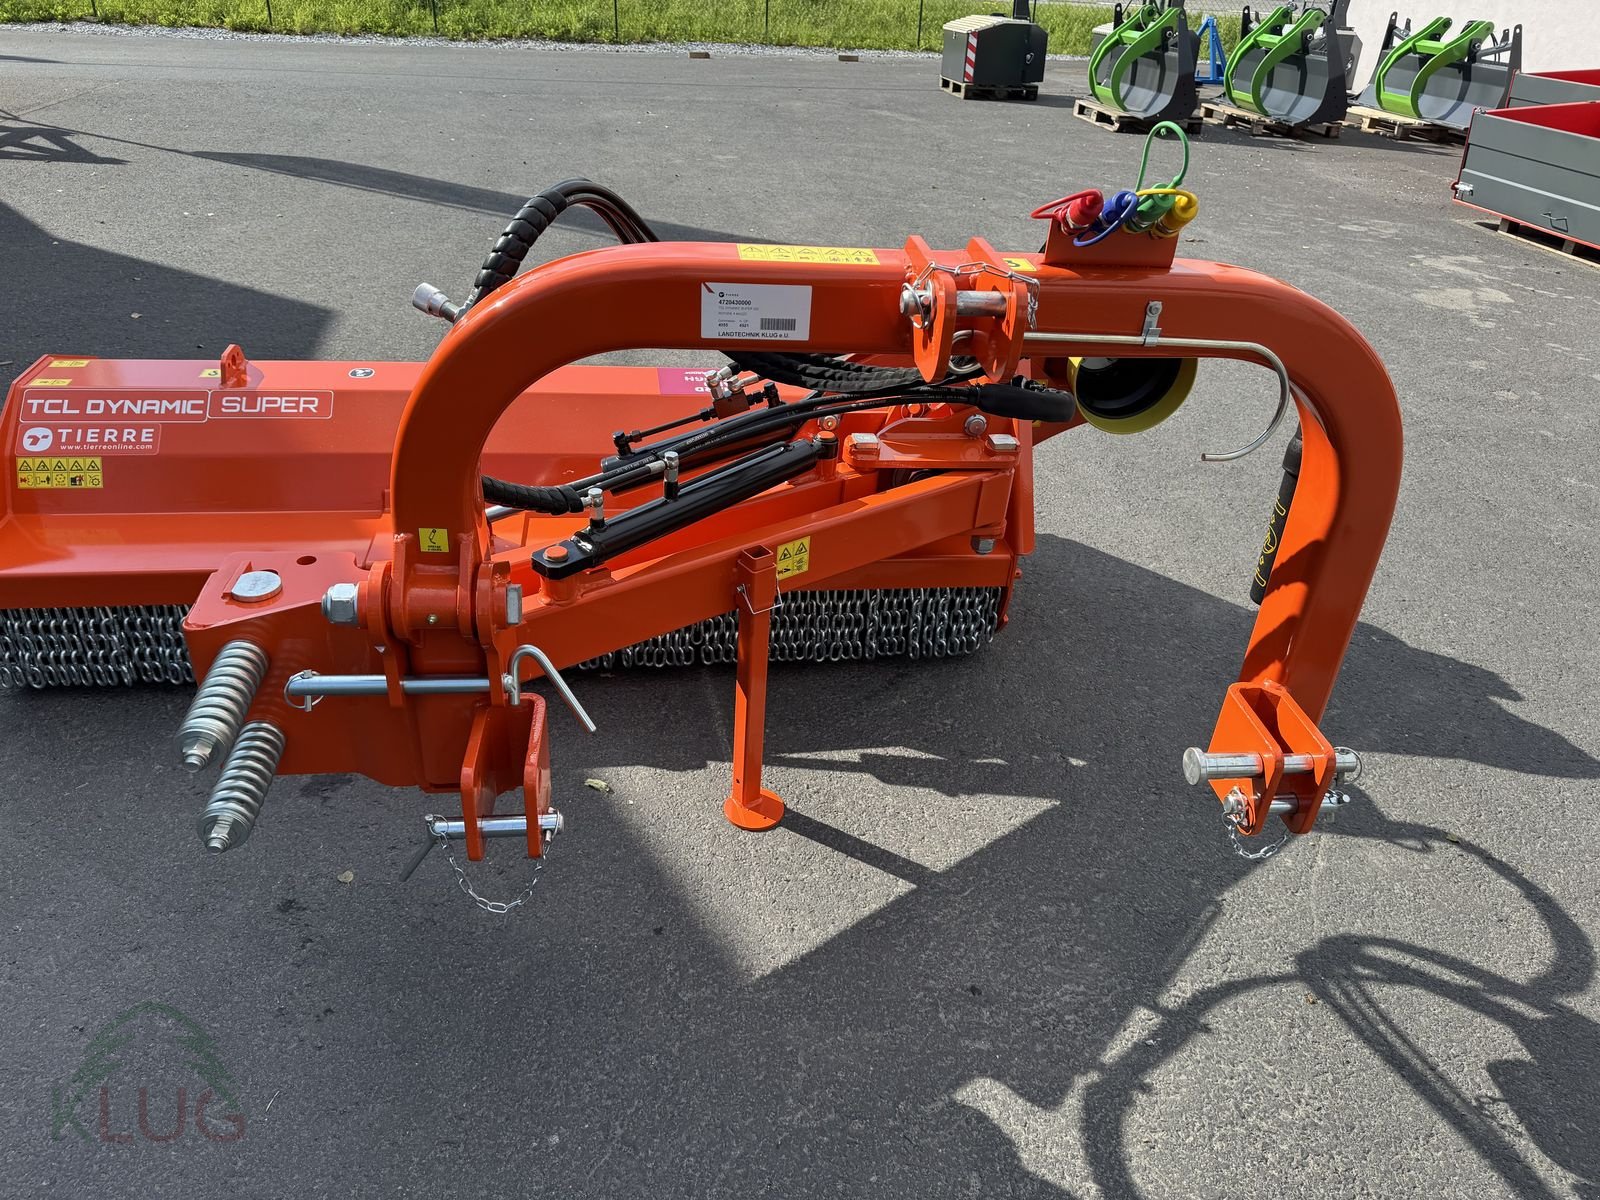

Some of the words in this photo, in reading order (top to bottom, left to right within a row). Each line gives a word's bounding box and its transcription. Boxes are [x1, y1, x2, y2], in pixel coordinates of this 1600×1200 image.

[26, 398, 80, 414] TCL
[85, 398, 204, 415] DYNAMIC
[220, 396, 319, 413] SUPER
[57, 428, 155, 443] TIERRE
[60, 443, 153, 451] www.tierreonline.com
